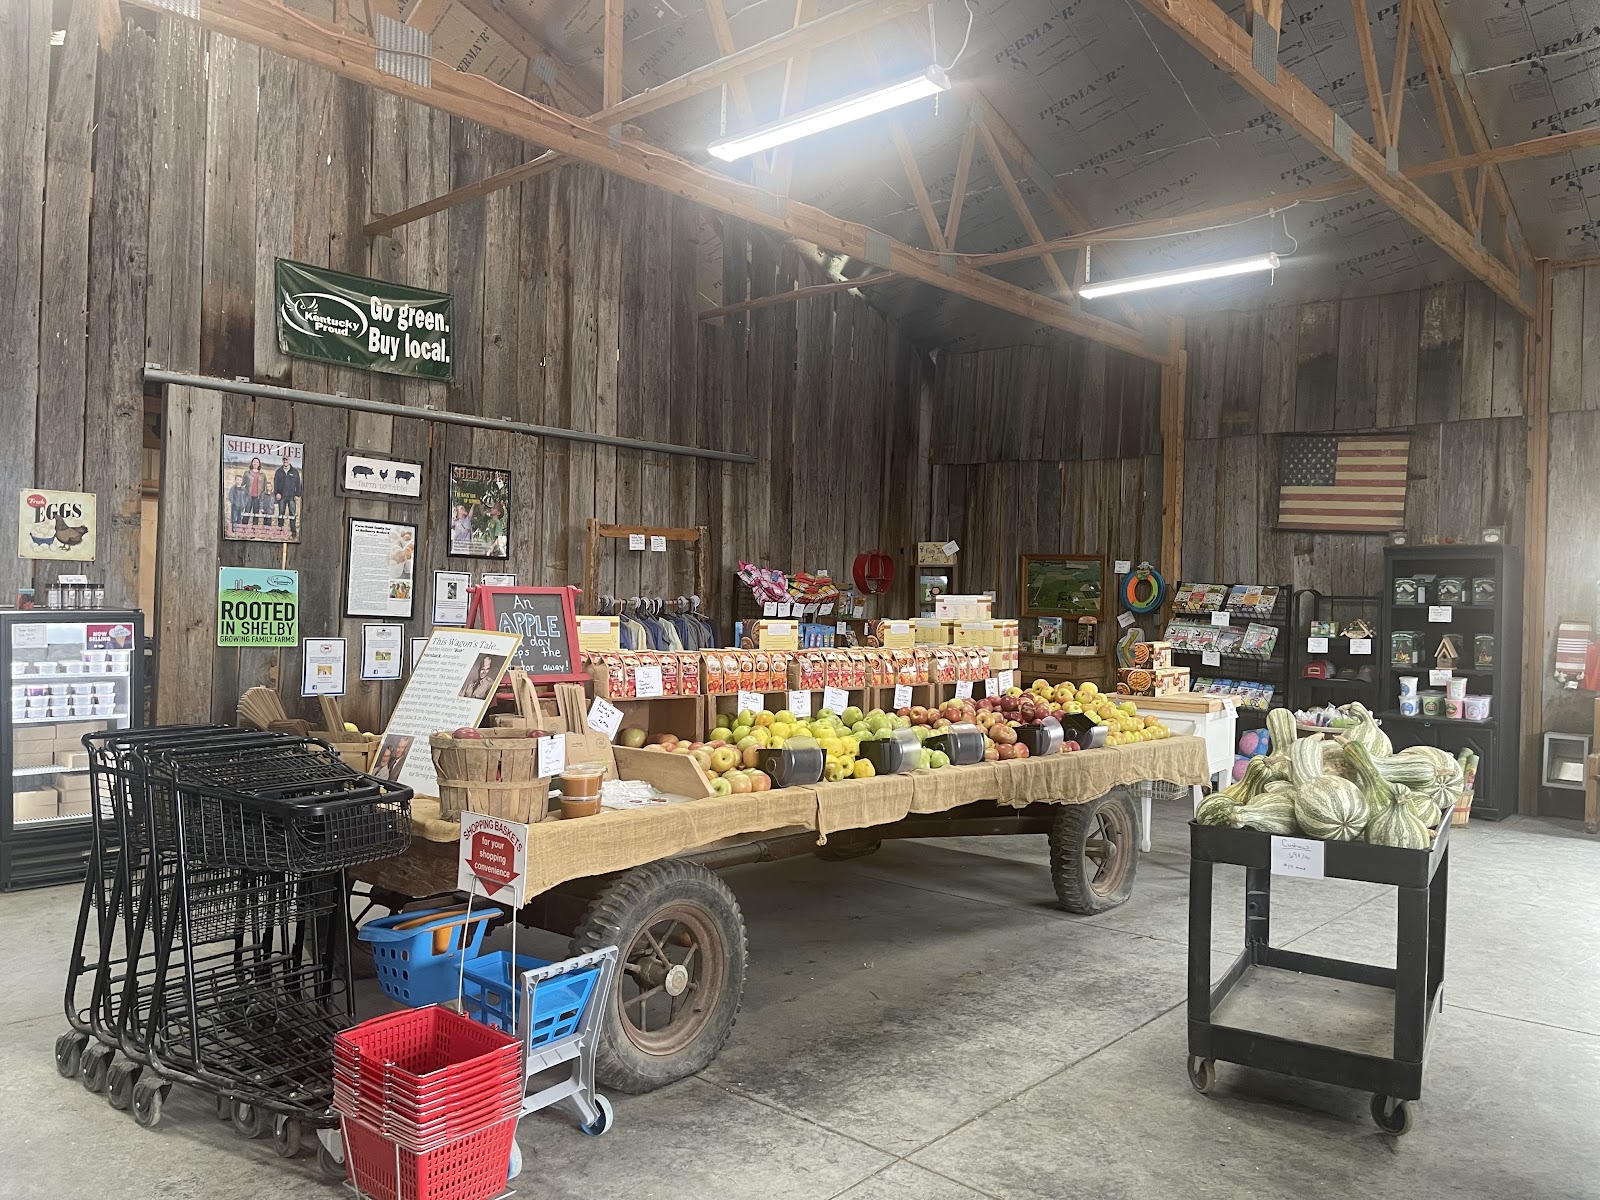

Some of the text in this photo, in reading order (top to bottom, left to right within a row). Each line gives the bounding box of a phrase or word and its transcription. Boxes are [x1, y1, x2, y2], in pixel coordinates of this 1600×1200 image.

[305, 311, 360, 332] Kentucky
[370, 296, 450, 333] Go green.
[315, 321, 349, 337] Proud
[368, 326, 450, 364] Buy local.
[228, 439, 301, 459] SHELBY LIFE
[453, 466, 488, 481] SHELBY
[358, 480, 408, 491] farm to table
[34, 502, 82, 524] EGGS
[513, 595, 534, 610] An
[221, 600, 296, 622] ROOTED
[221, 621, 295, 636] IN SHELBY
[499, 612, 561, 638] APPLE
[220, 635, 250, 643] GROWING
[449, 638, 478, 648] Wagon's
[480, 641, 501, 650] Tale...
[530, 635, 551, 648] day
[541, 647, 562, 657] the
[542, 660, 569, 673] away!
[463, 819, 523, 852] SHOPPING BASKETS
[481, 835, 505, 850] for your
[479, 849, 507, 866] shopping
[474, 861, 511, 879] convenience
